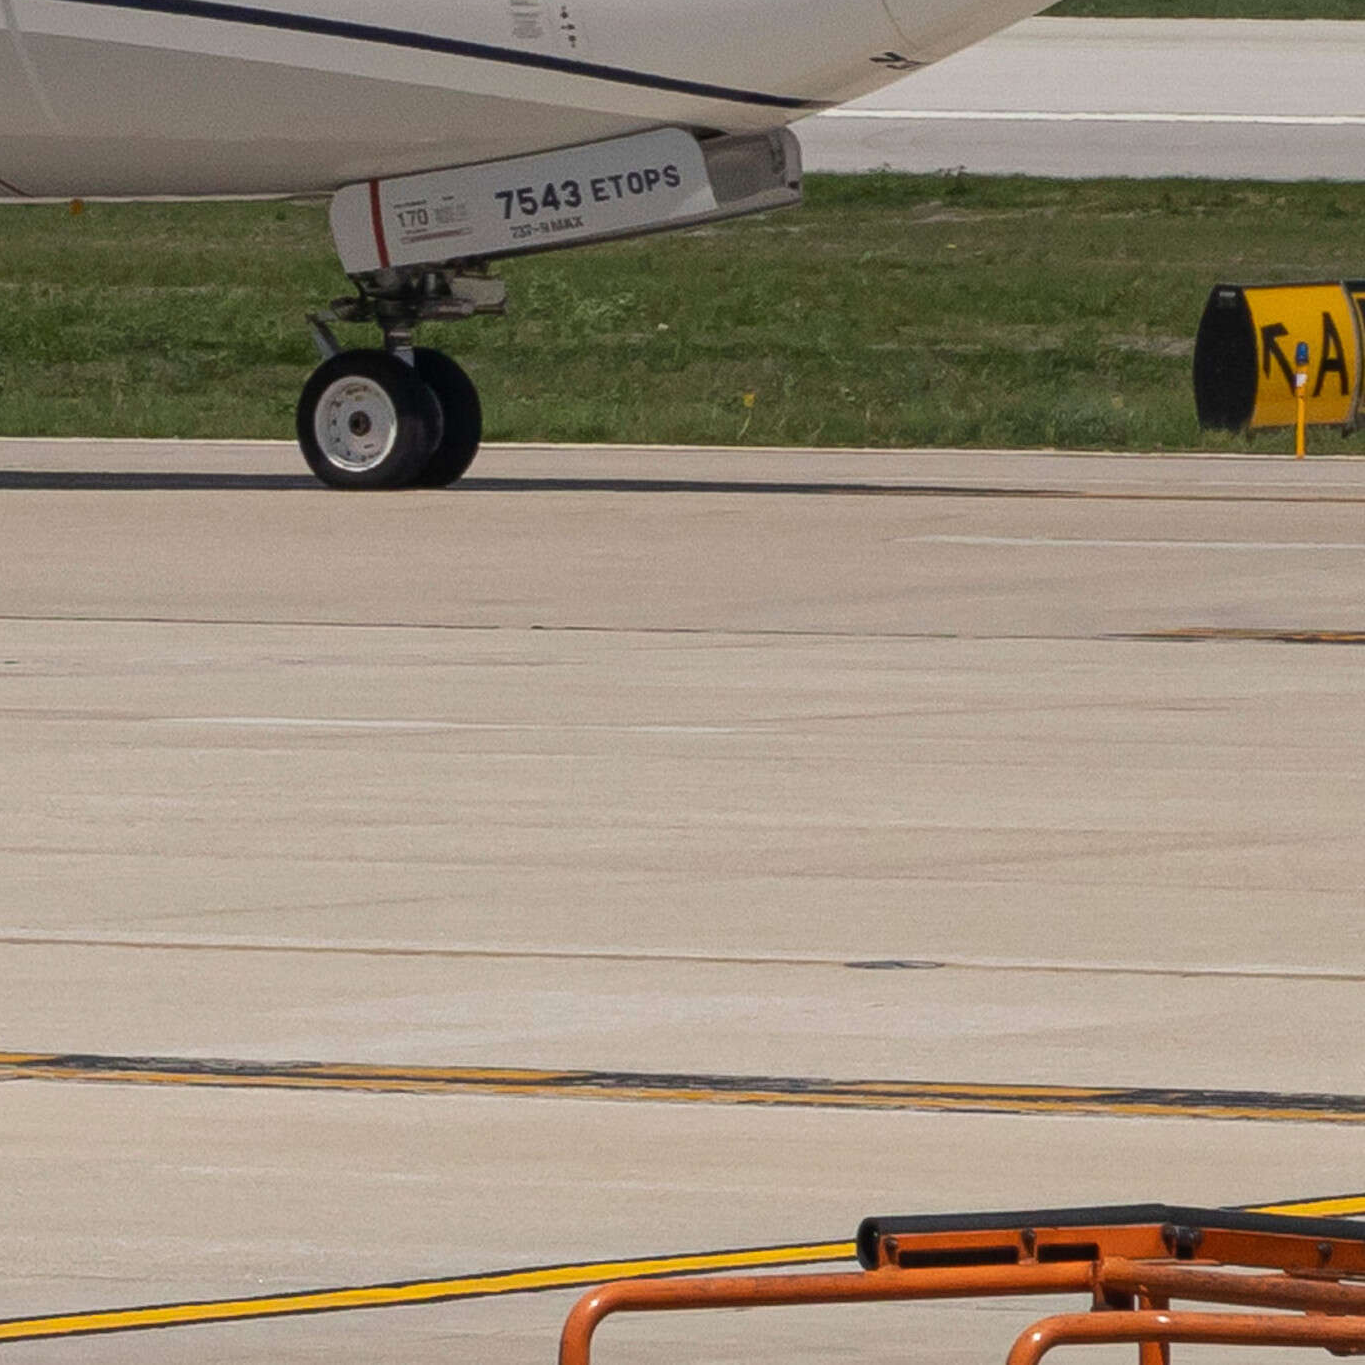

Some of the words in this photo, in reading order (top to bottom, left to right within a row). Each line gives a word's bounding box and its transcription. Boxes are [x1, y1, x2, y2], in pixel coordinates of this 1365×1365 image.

[397, 208, 429, 228] 170
[494, 180, 582, 220] 7543
[589, 164, 681, 202] ETOPS
[1311, 311, 1350, 398] A
